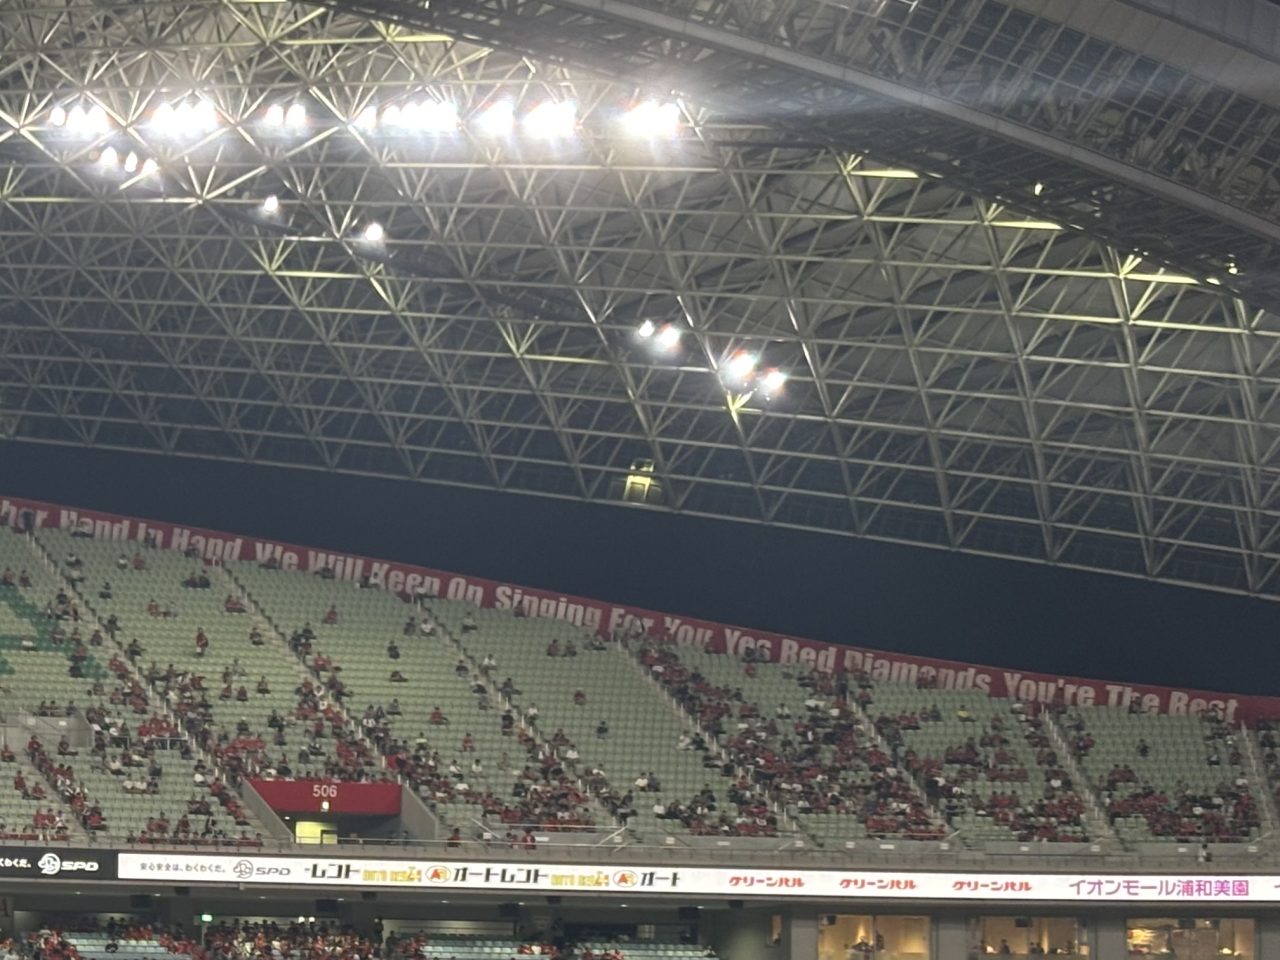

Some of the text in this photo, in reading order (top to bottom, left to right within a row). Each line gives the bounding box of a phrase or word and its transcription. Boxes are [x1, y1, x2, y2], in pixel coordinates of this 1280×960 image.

[60, 510, 130, 541] Hand
[172, 527, 242, 561] Hand
[779, 638, 838, 674] Red
[312, 784, 338, 798] 506
[1069, 880, 1250, 897] イオンモール浦和美園
